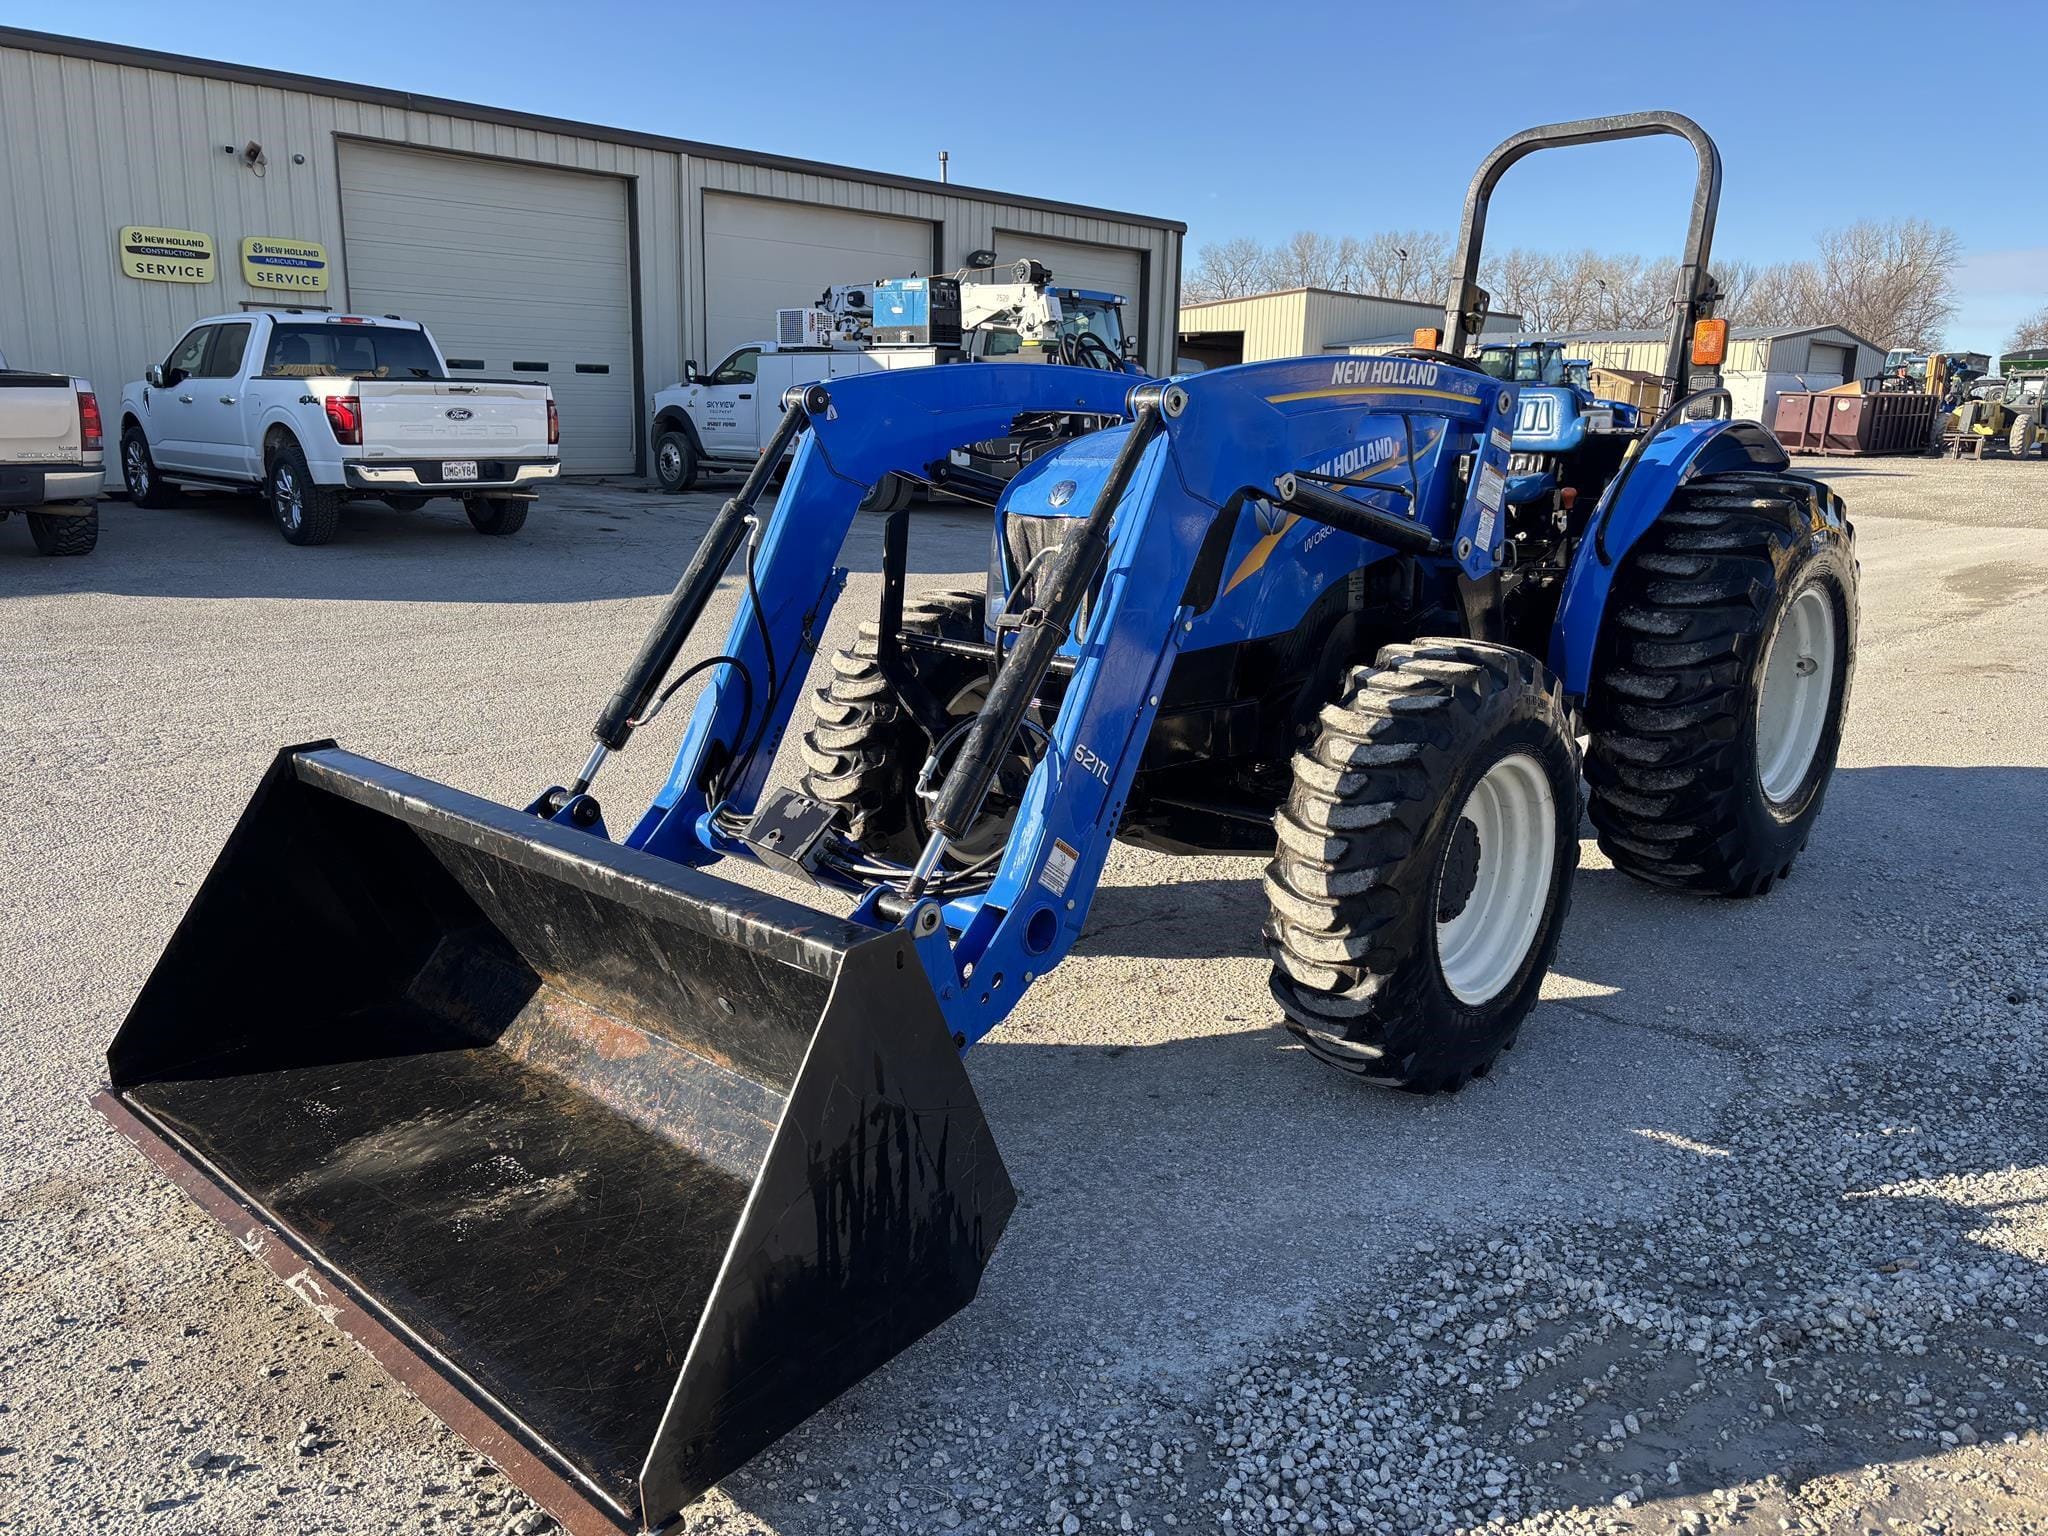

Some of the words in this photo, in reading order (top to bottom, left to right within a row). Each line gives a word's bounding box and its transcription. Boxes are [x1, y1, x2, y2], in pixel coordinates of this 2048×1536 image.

[144, 235, 165, 245] NEW
[166, 236, 204, 248] HOLLAND
[140, 246, 196, 257] CONSTRUCTION
[264, 246, 283, 255] NEW
[284, 247, 319, 258] HOLLAND
[265, 257, 308, 267] AGRICULTURE
[136, 262, 204, 278] SERVICE
[257, 271, 319, 286] SERVICE
[1331, 361, 1371, 385] NEW
[1371, 362, 1438, 386] HOLLAND
[1333, 436, 1393, 479] HOLLAND
[1074, 743, 1109, 785] 621TL
